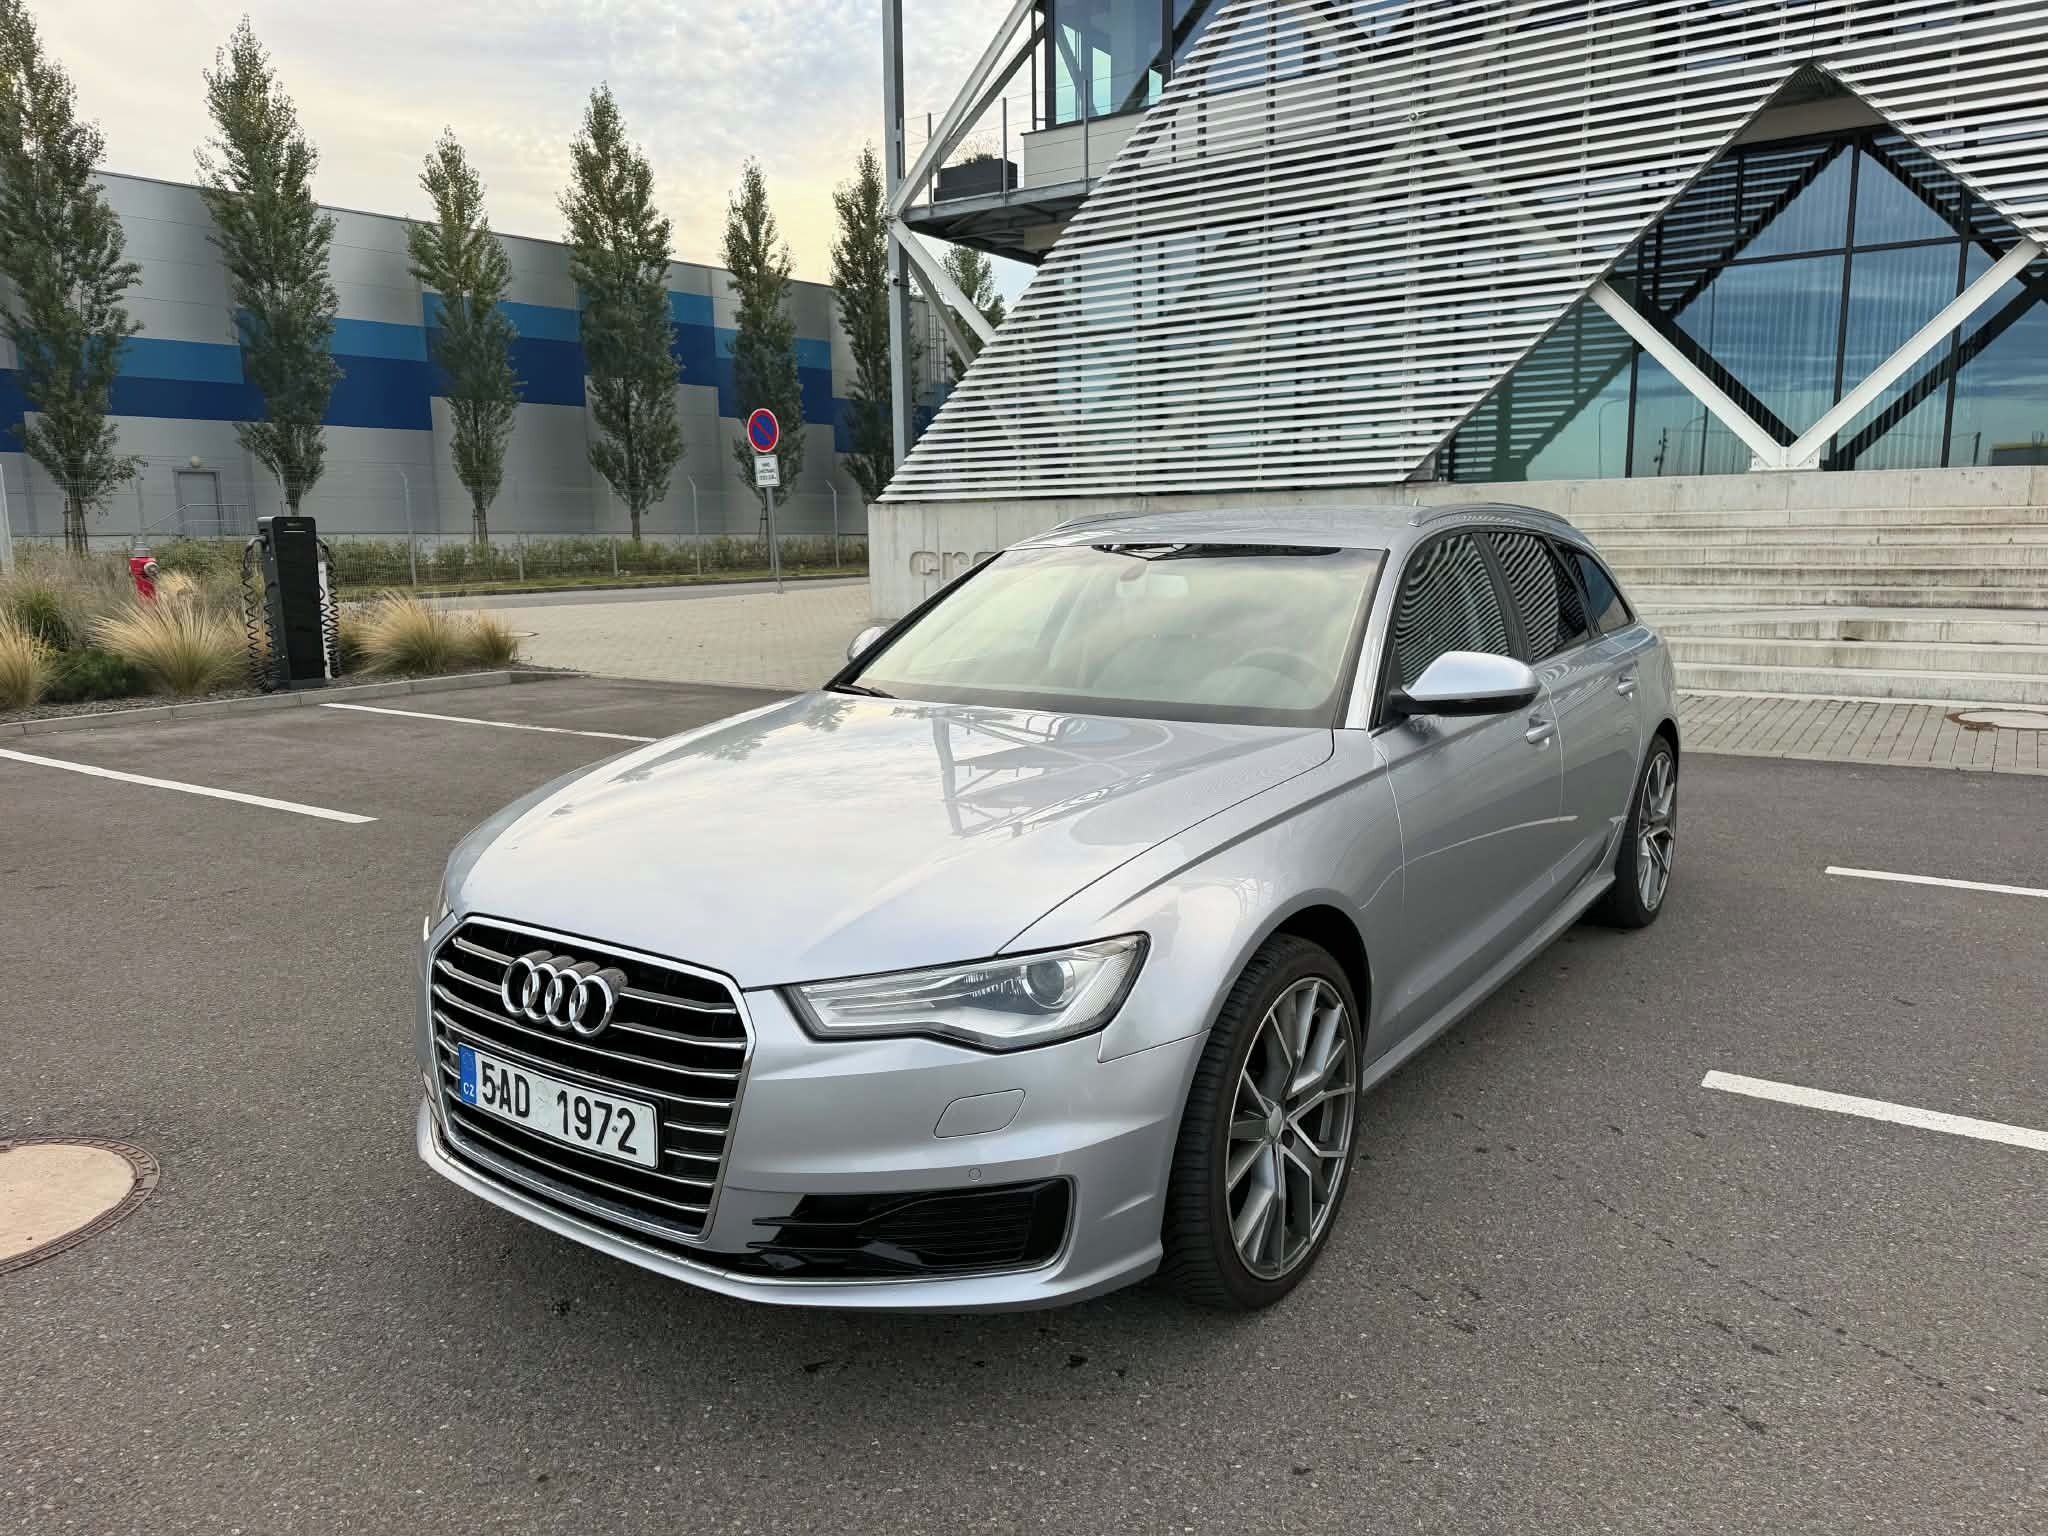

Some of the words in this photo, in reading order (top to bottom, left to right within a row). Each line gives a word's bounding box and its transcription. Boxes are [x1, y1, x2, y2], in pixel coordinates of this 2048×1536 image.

[463, 1082, 474, 1097] CZ
[481, 1060, 530, 1118] 5AD
[556, 1088, 637, 1155] 1972
